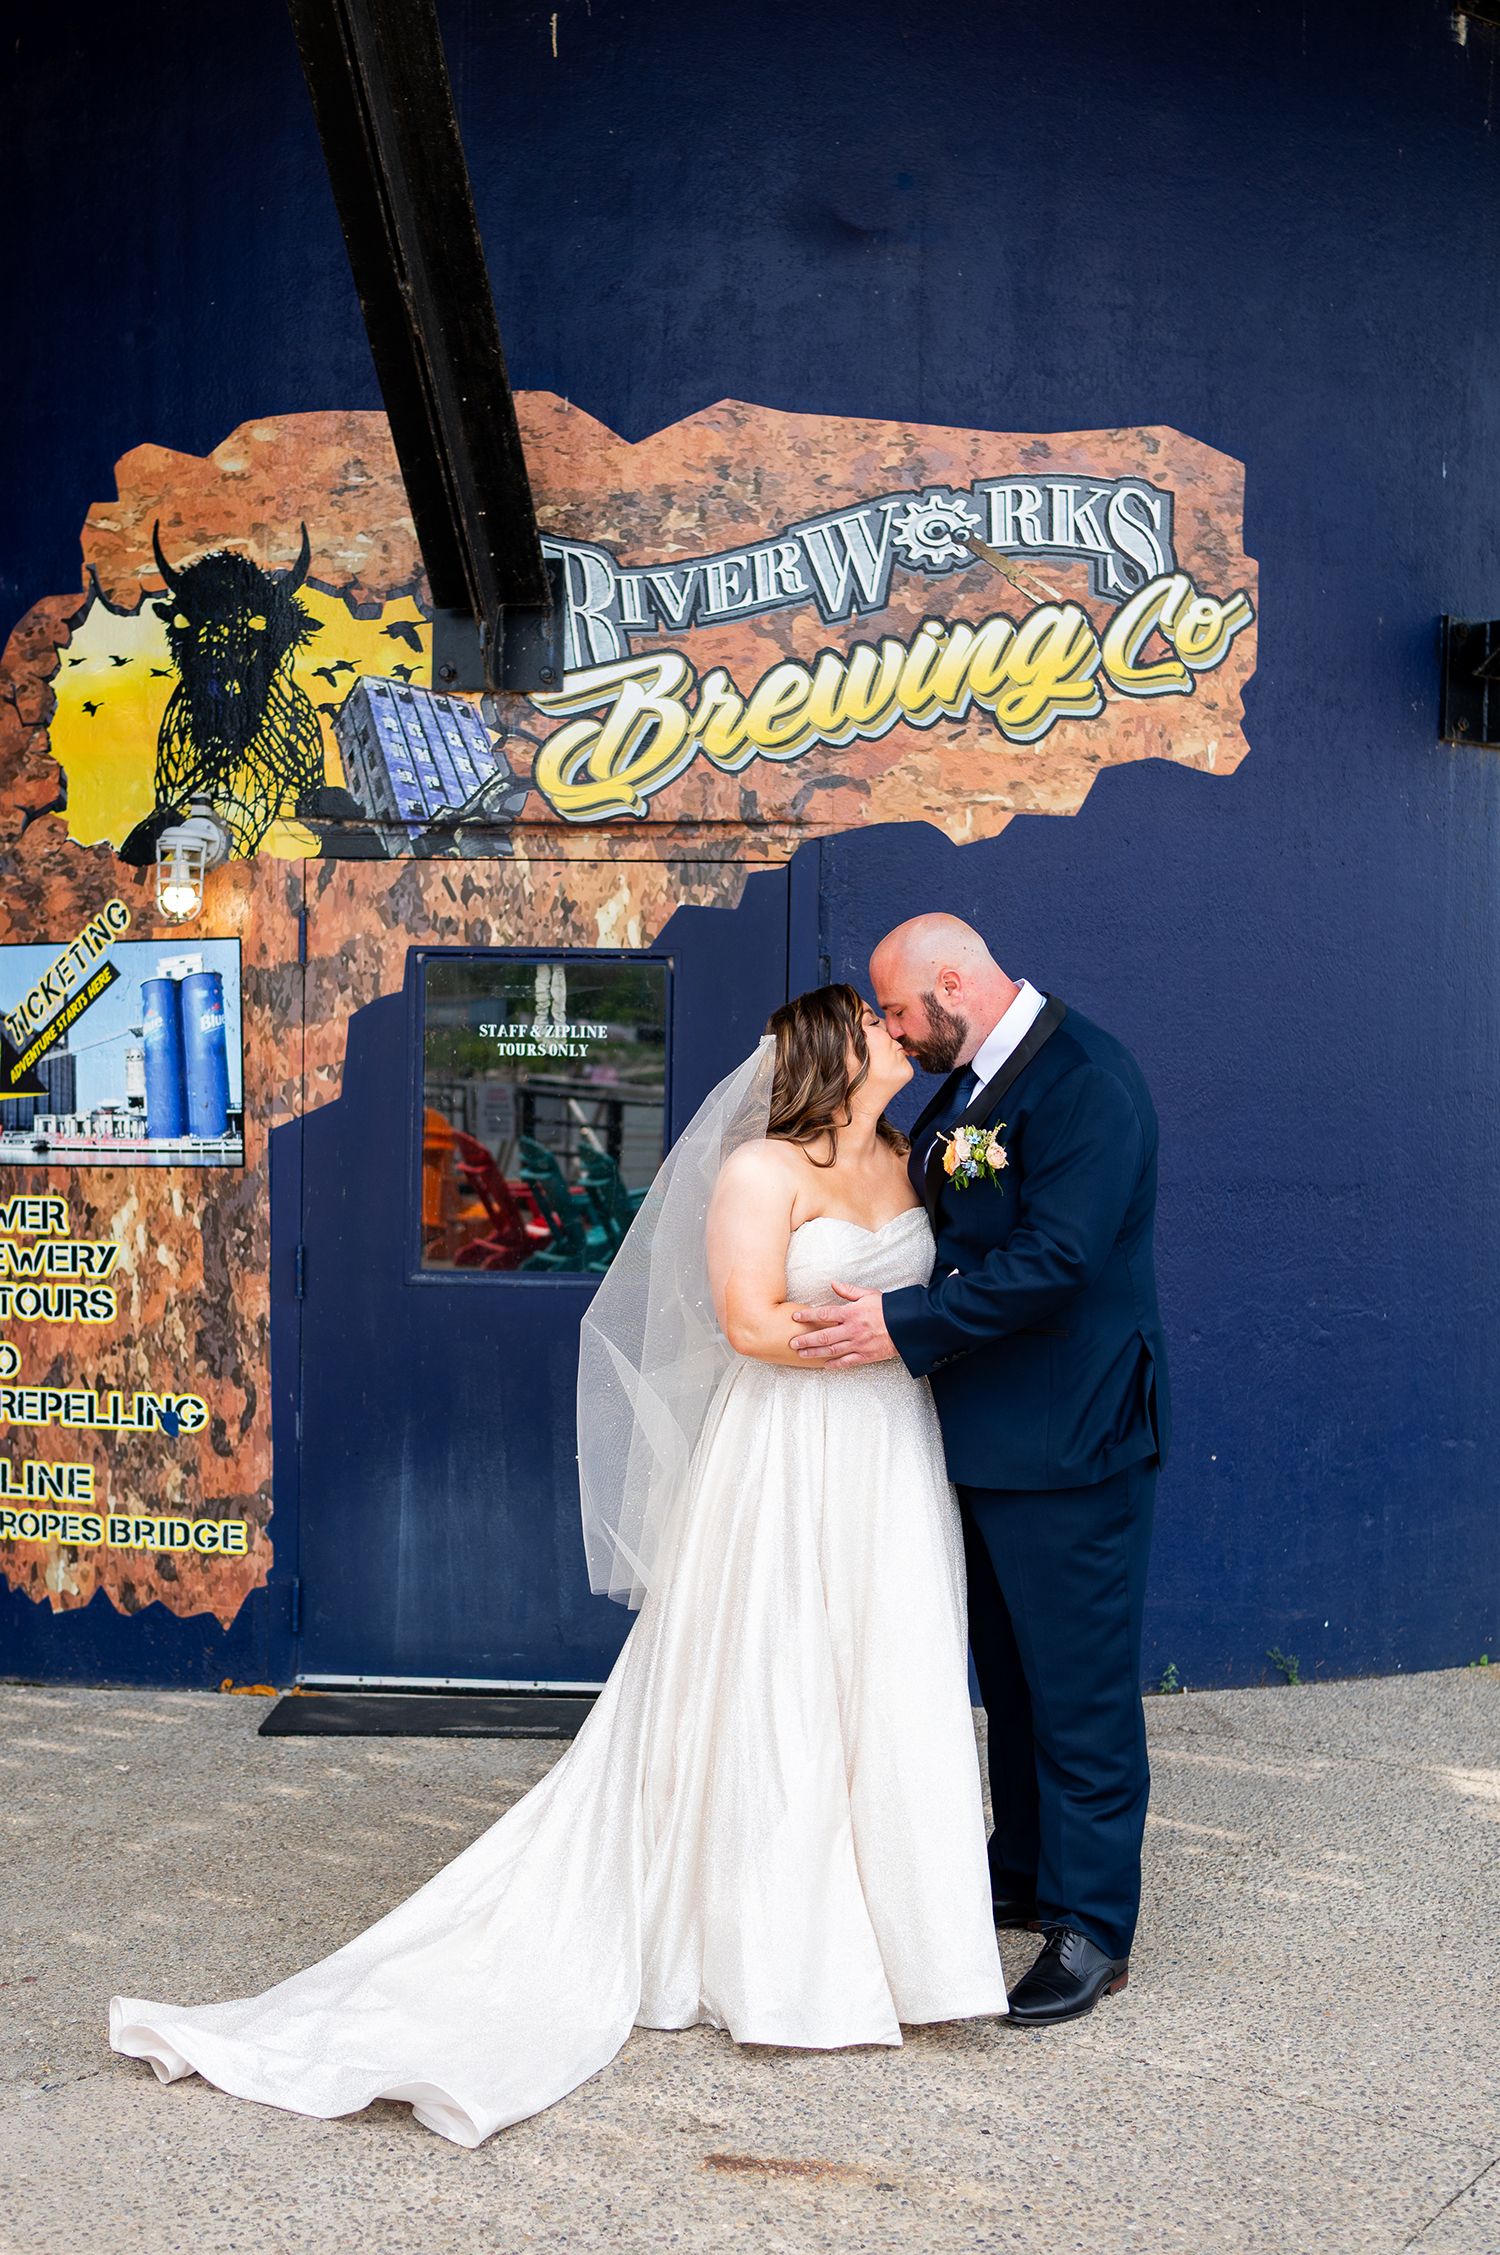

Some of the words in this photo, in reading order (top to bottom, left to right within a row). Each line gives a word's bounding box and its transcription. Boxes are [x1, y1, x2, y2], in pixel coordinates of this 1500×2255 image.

[528, 600, 1104, 822] Brewing
[1100, 571, 1257, 698] Co
[5, 900, 129, 1043] TICKETING
[10, 1030, 58, 1084] ADVENTURE
[57, 995, 88, 1032] STARTS
[87, 966, 113, 1000] HERE
[479, 1024, 529, 1038] STAFF
[530, 1024, 541, 1038] &
[544, 1024, 608, 1039] ZIPLINE
[497, 1043, 546, 1057] TOURS
[547, 1043, 589, 1057] ONLY
[0, 1243, 118, 1274] WERY
[0, 1286, 115, 1319] TOURS
[0, 1391, 207, 1428] REPELLING
[1, 1462, 93, 1499] LINE
[0, 1512, 102, 1542] ROPES
[109, 1519, 244, 1550] BRIDGE
